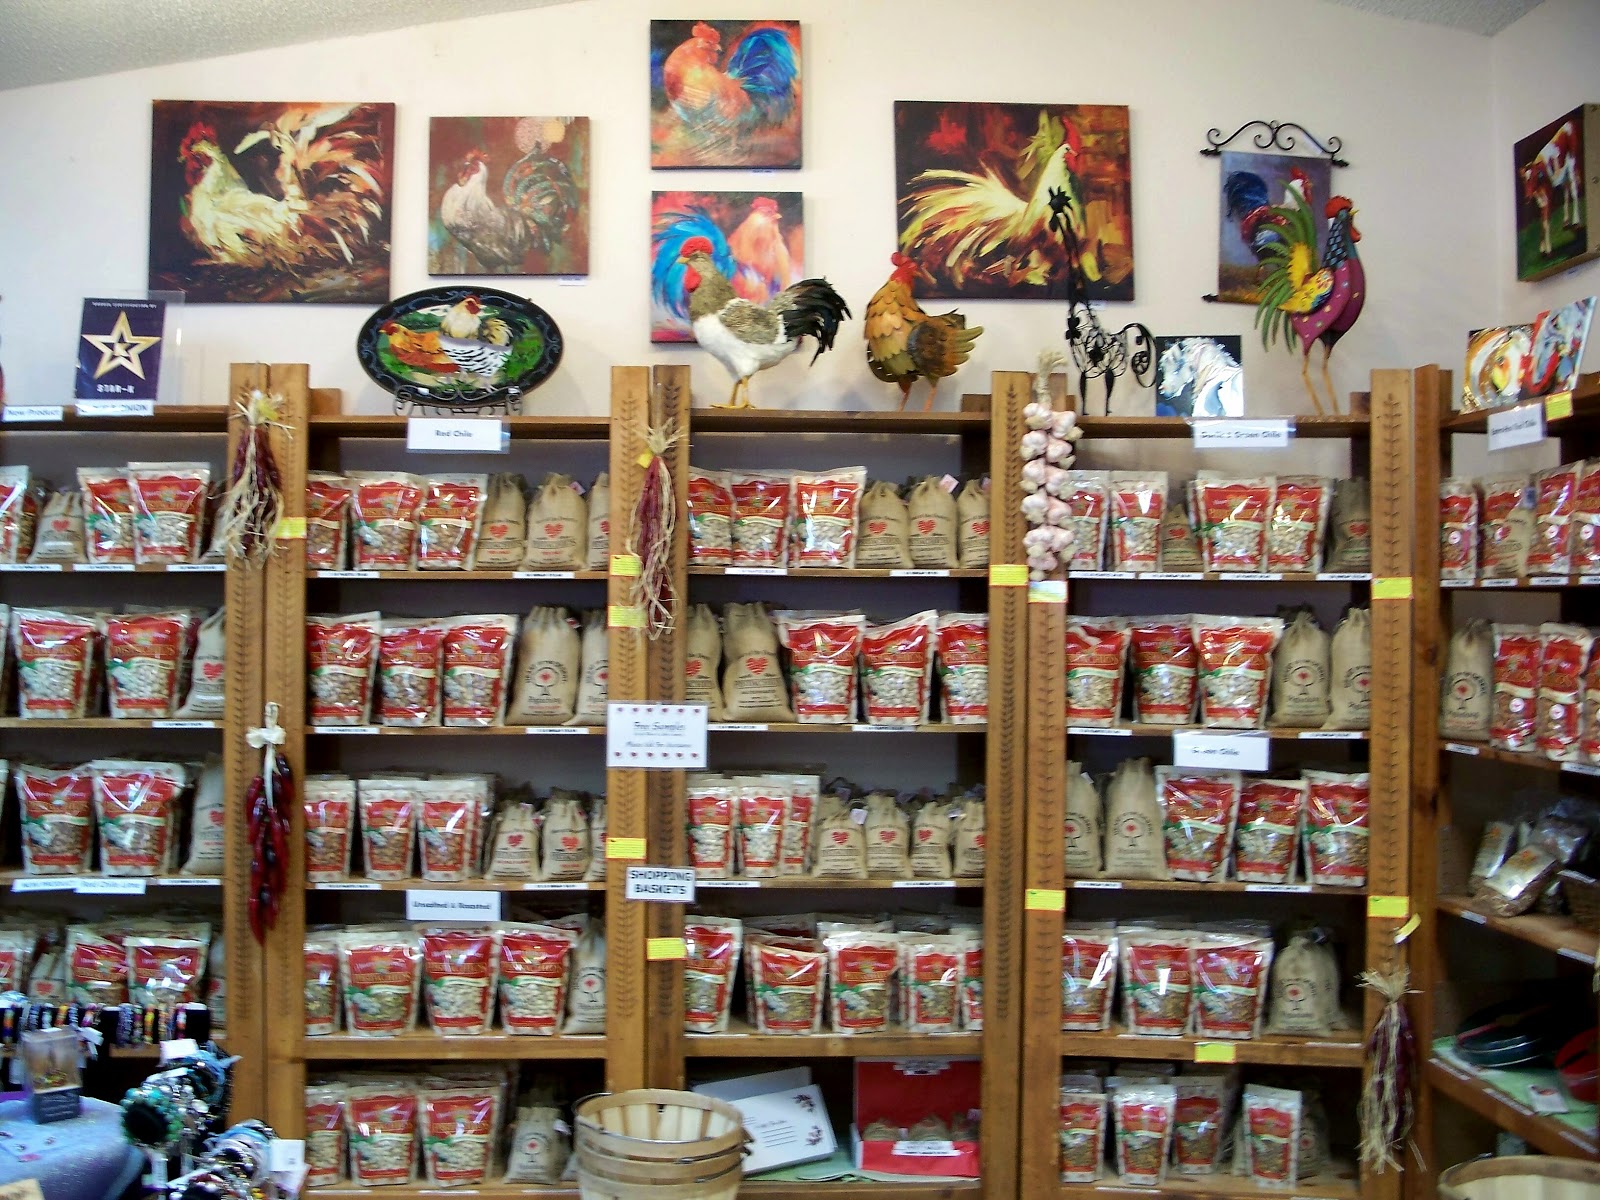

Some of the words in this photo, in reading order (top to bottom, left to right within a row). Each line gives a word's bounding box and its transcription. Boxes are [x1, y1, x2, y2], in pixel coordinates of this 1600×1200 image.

[96, 383, 135, 394] STAR-K
[629, 870, 693, 881] SHOPPING
[634, 883, 687, 895] BASKETS
